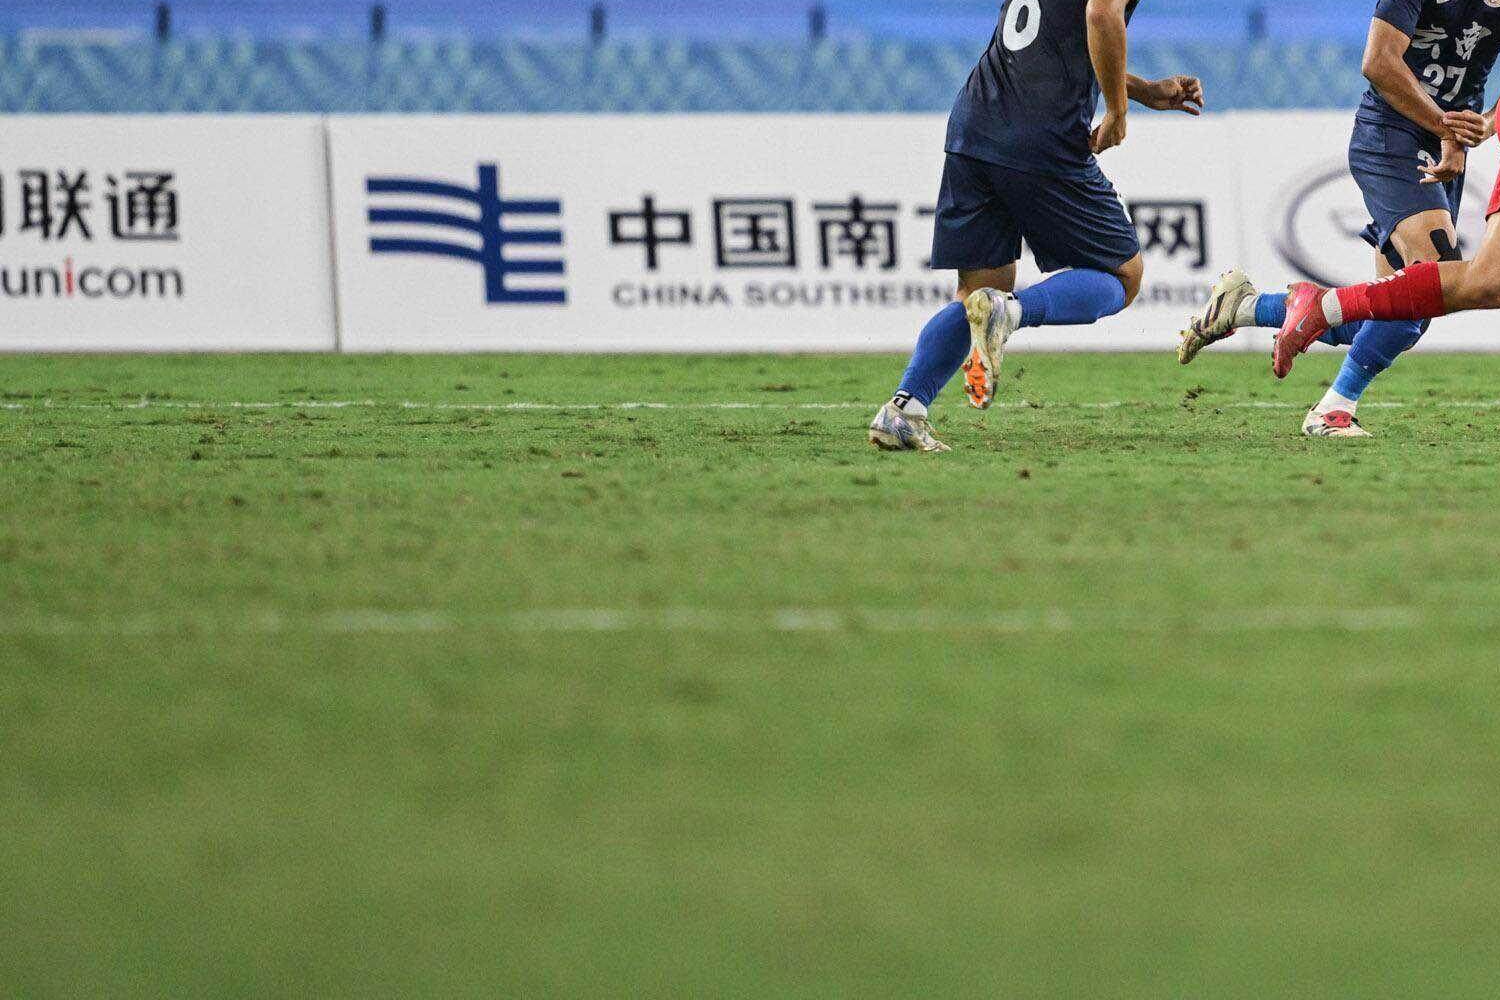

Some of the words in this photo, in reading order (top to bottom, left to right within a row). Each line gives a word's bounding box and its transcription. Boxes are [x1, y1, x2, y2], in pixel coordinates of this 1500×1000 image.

[1421, 63, 1467, 102] 27
[0, 168, 180, 241] 联通
[608, 194, 1209, 270] 中国南网
[1, 256, 184, 297] unicom
[613, 281, 731, 307] CHINA
